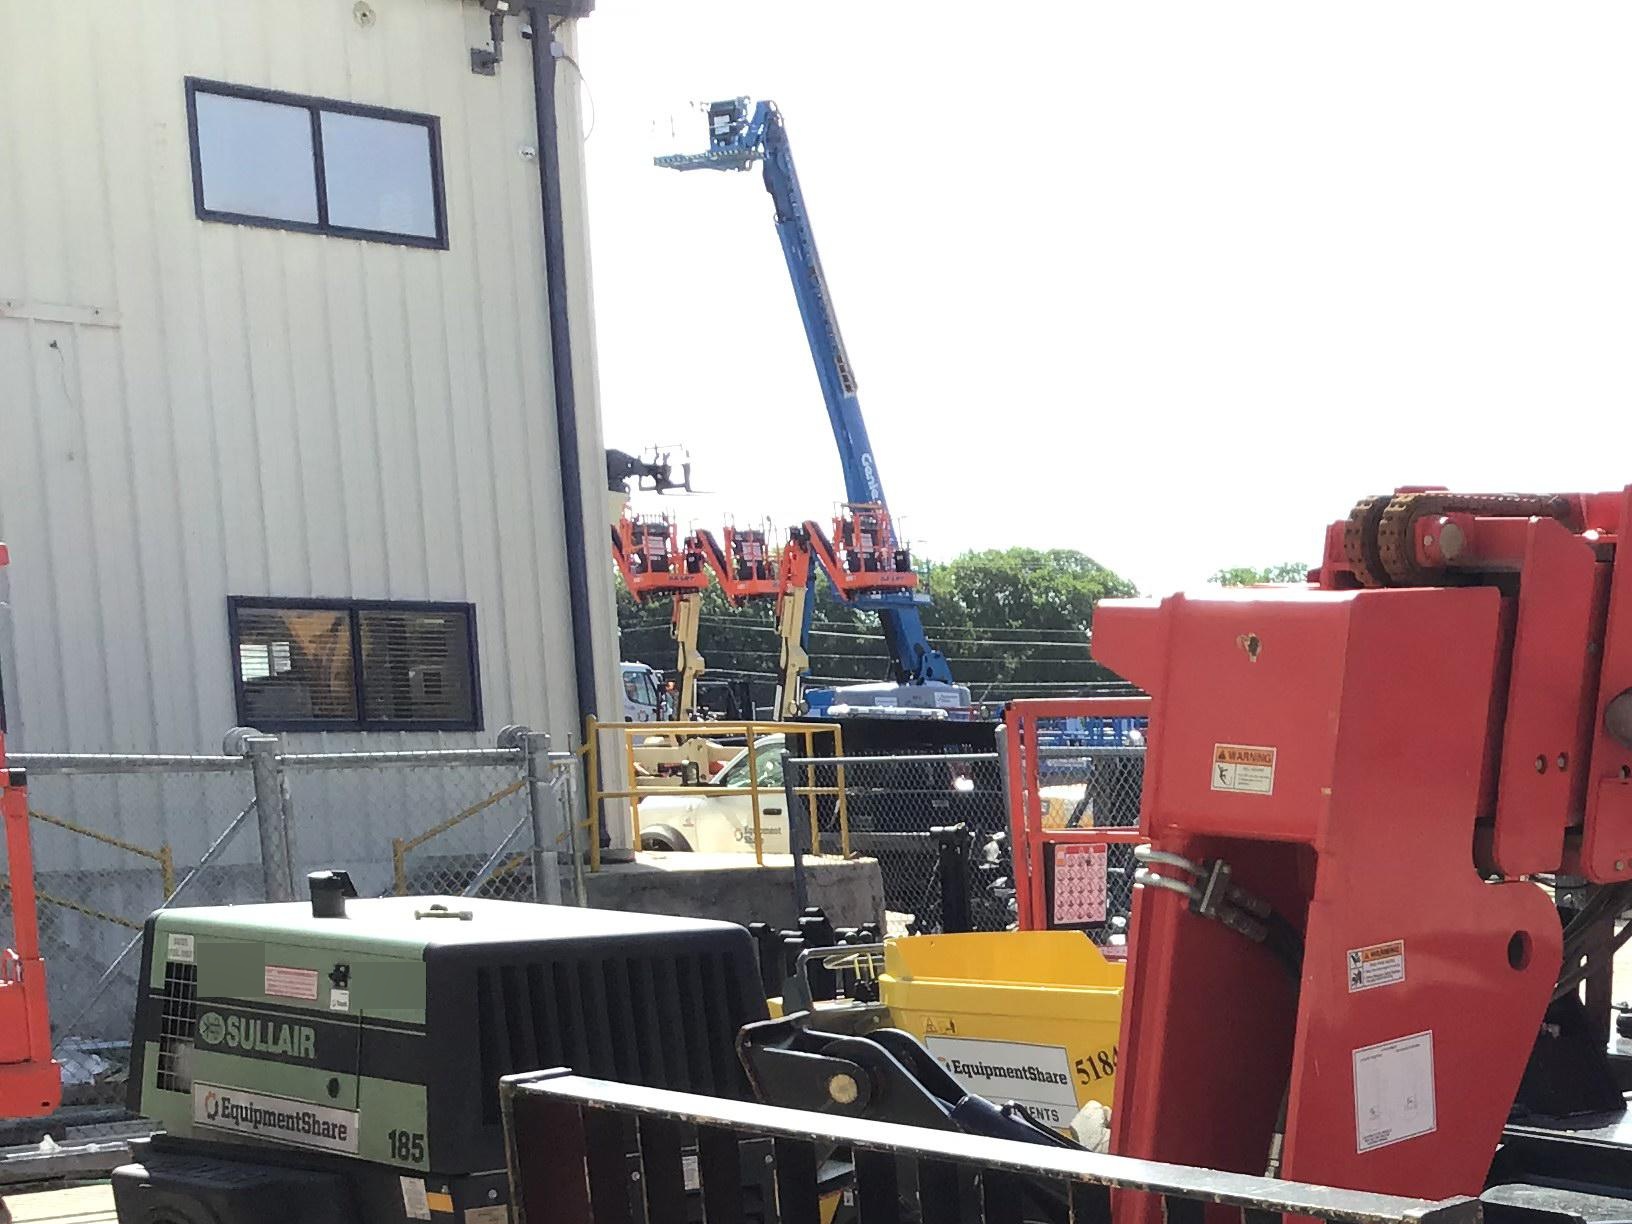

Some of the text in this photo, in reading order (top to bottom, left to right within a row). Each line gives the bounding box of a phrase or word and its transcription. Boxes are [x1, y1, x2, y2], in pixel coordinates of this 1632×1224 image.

[861, 452, 880, 500] Genie
[224, 1015, 316, 1060] SULLAIR
[953, 1060, 1068, 1086] EquipmentShare
[220, 1096, 348, 1142] EquipmentShare
[388, 1129, 425, 1163] 185
